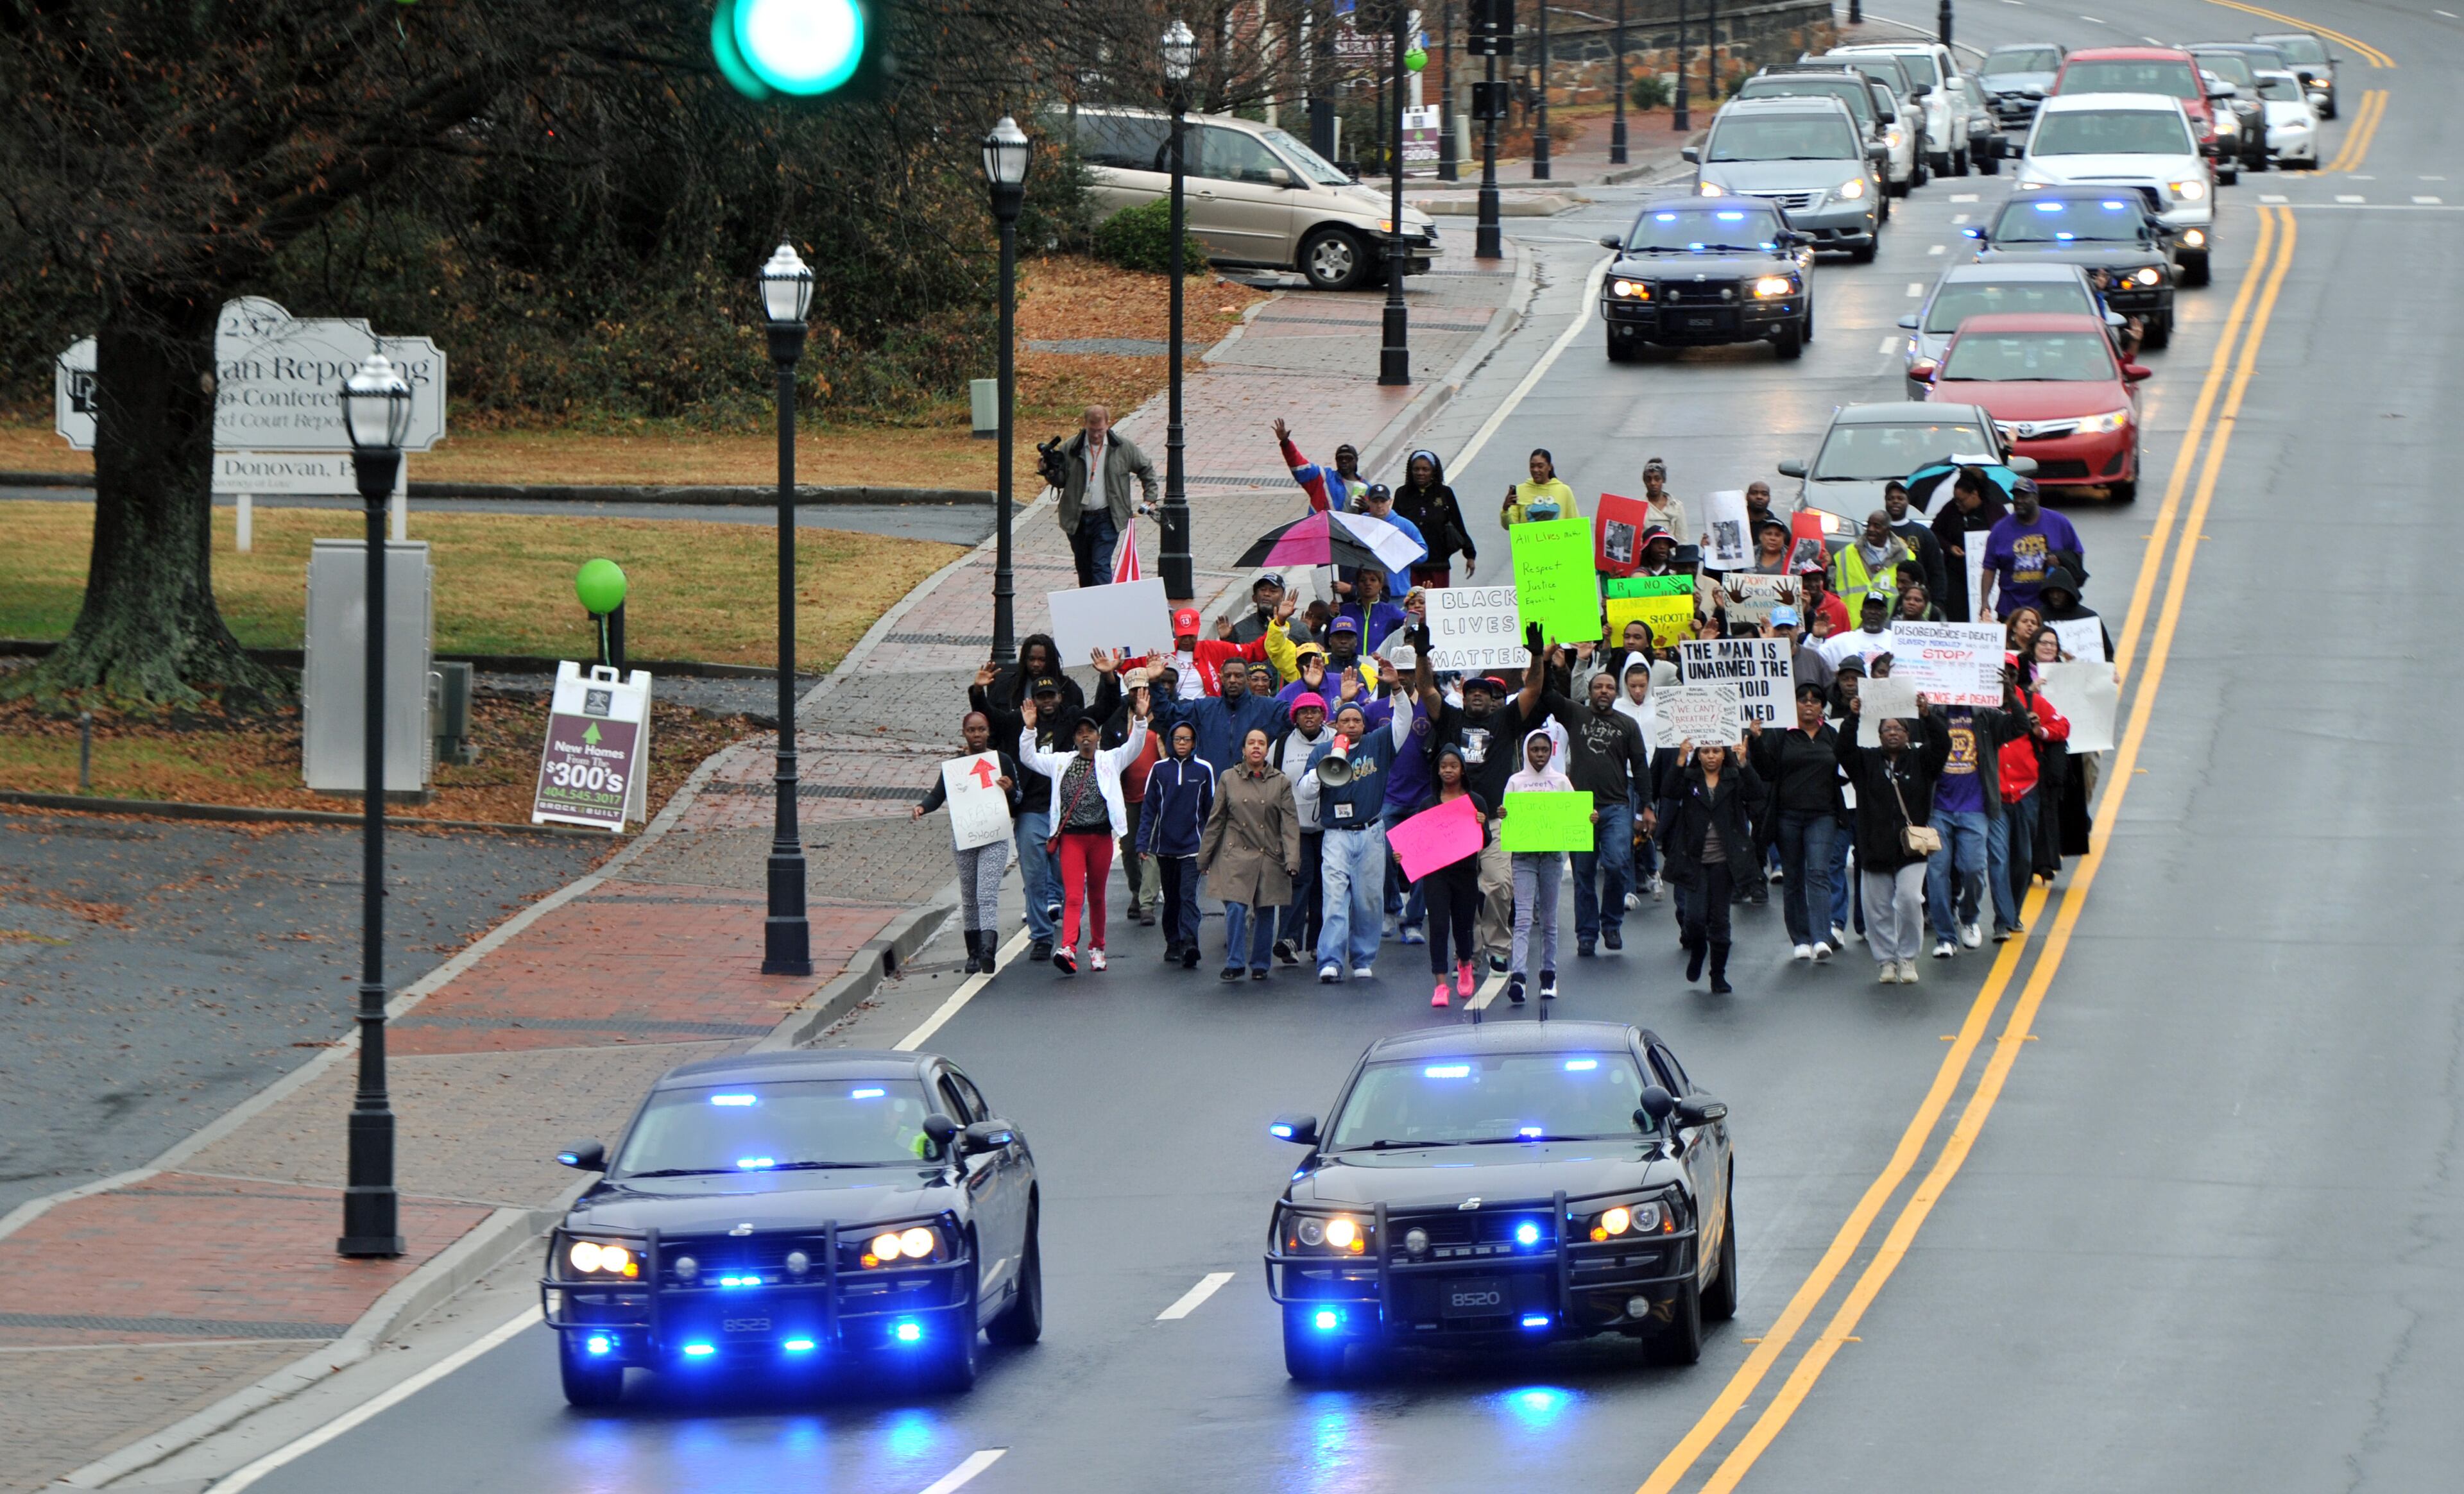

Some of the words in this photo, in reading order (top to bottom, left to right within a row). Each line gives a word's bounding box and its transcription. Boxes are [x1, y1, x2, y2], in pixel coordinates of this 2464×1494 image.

[275, 356, 430, 388] Repong
[241, 414, 287, 429] Court
[1516, 534, 1530, 545] All
[1536, 532, 1560, 543] Lives
[1523, 561, 1562, 575] Respect
[1526, 580, 1556, 593] Justice
[1745, 587, 1775, 597] SHOOT
[1442, 590, 1518, 609] BLACK
[1443, 615, 1515, 635] LIVES
[1894, 625, 1960, 639] DISOBEDIENCE
[1969, 631, 1998, 641] DEATH
[1432, 647, 1526, 668] MATTER
[1684, 643, 1712, 660] THE
[1718, 641, 1752, 658] MAN
[1761, 642, 1776, 659] IS
[1922, 649, 1973, 660] STOP!
[1688, 660, 1756, 679] UNARMED
[1760, 661, 1788, 677] THE
[1970, 693, 1999, 705] DEATH
[554, 740, 583, 754] New
[585, 744, 626, 760] Homes
[566, 754, 590, 765] From
[592, 756, 610, 767] The
[545, 761, 624, 793] $300's
[543, 786, 622, 804] 404.545.3017
[539, 802, 577, 812] BROCK
[586, 808, 620, 817] BUILT
[968, 826, 1001, 842] SHOOT
[1452, 1291, 1500, 1307] 8520
[723, 1318, 771, 1332] 8523
